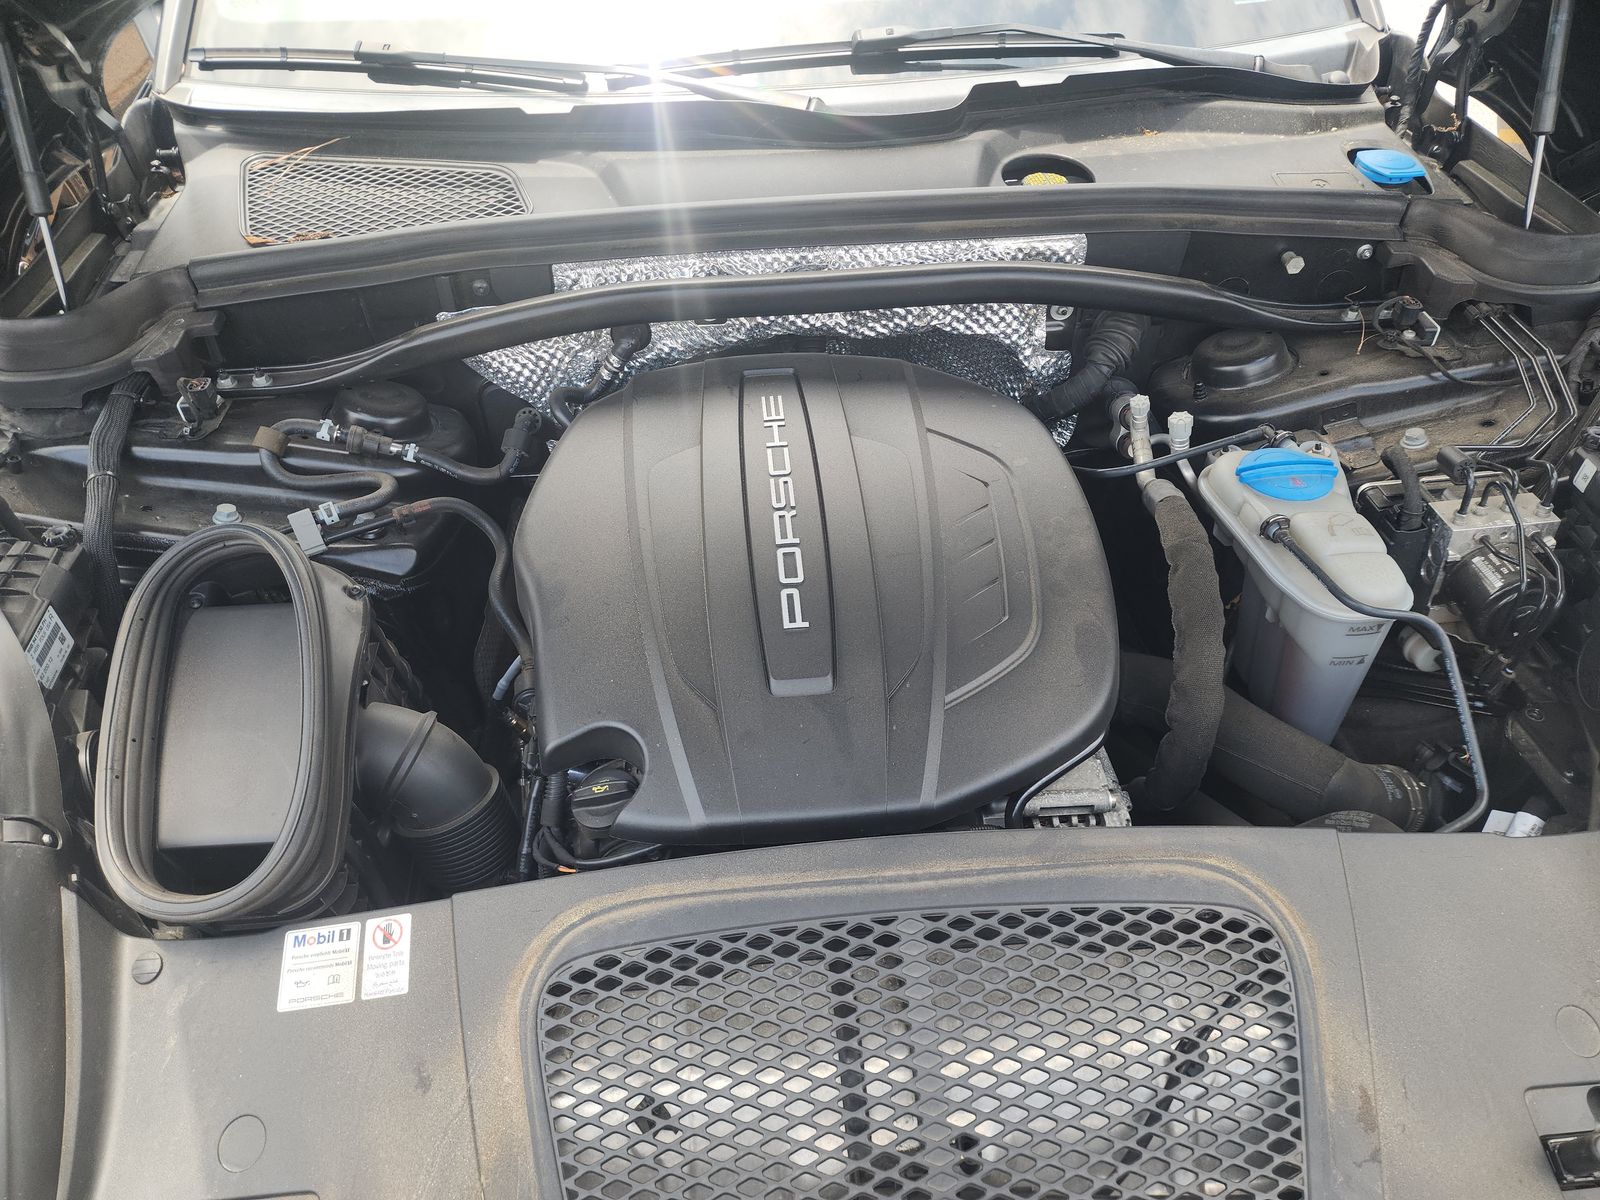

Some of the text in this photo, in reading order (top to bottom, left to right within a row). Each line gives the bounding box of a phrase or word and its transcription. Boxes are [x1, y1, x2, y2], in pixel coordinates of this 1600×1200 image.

[761, 395, 809, 628] PORSCHE
[1348, 625, 1376, 633] MAX
[293, 930, 335, 948] Mobil
[288, 992, 344, 1004] PORSCHE
